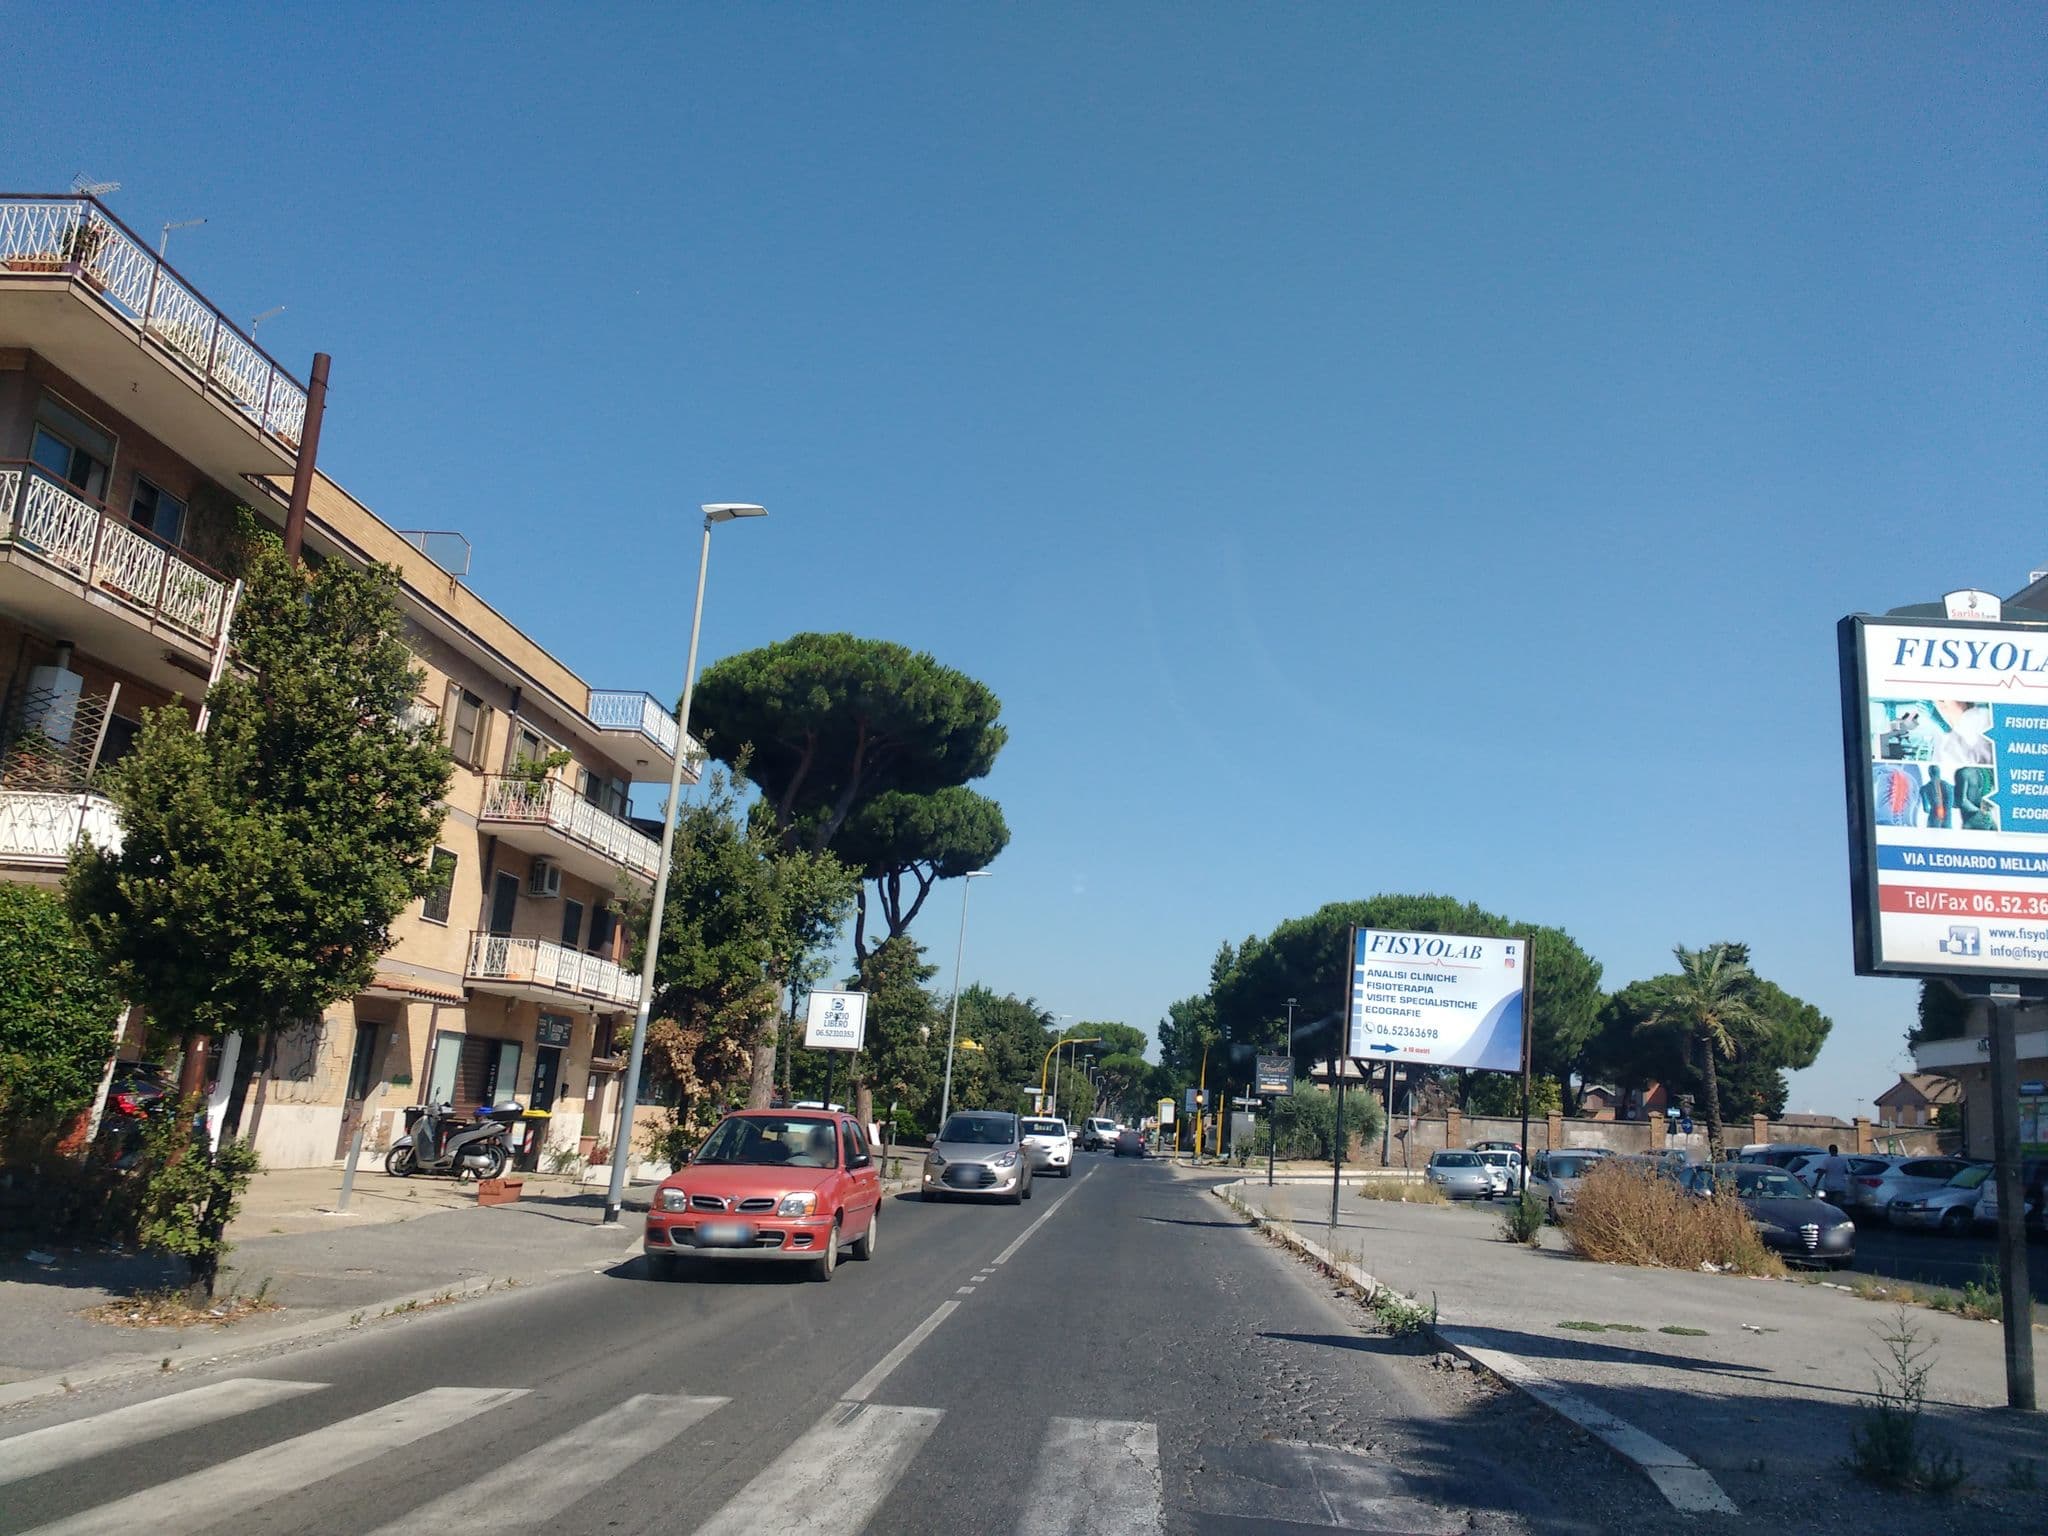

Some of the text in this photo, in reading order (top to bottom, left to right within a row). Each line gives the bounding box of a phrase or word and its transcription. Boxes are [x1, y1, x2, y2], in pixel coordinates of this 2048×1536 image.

[2008, 741, 2048, 755] ANALIS
[2010, 768, 2046, 783] VISITE
[1903, 852, 1926, 866] VIA
[1929, 854, 1997, 869] LEONARDO
[1904, 890, 2048, 915] Tel/Fax 06.52.36
[1368, 934, 1483, 960] FISYOLAB
[1367, 969, 1458, 983] ANALISI CLINICHE
[1366, 981, 1434, 994] FISIOTERAPIA
[1366, 994, 1478, 1010] VISITE SPECIALISTICHE
[1365, 1005, 1422, 1017] ECOGRAFIE
[1376, 1024, 1438, 1039] 06.52363698
